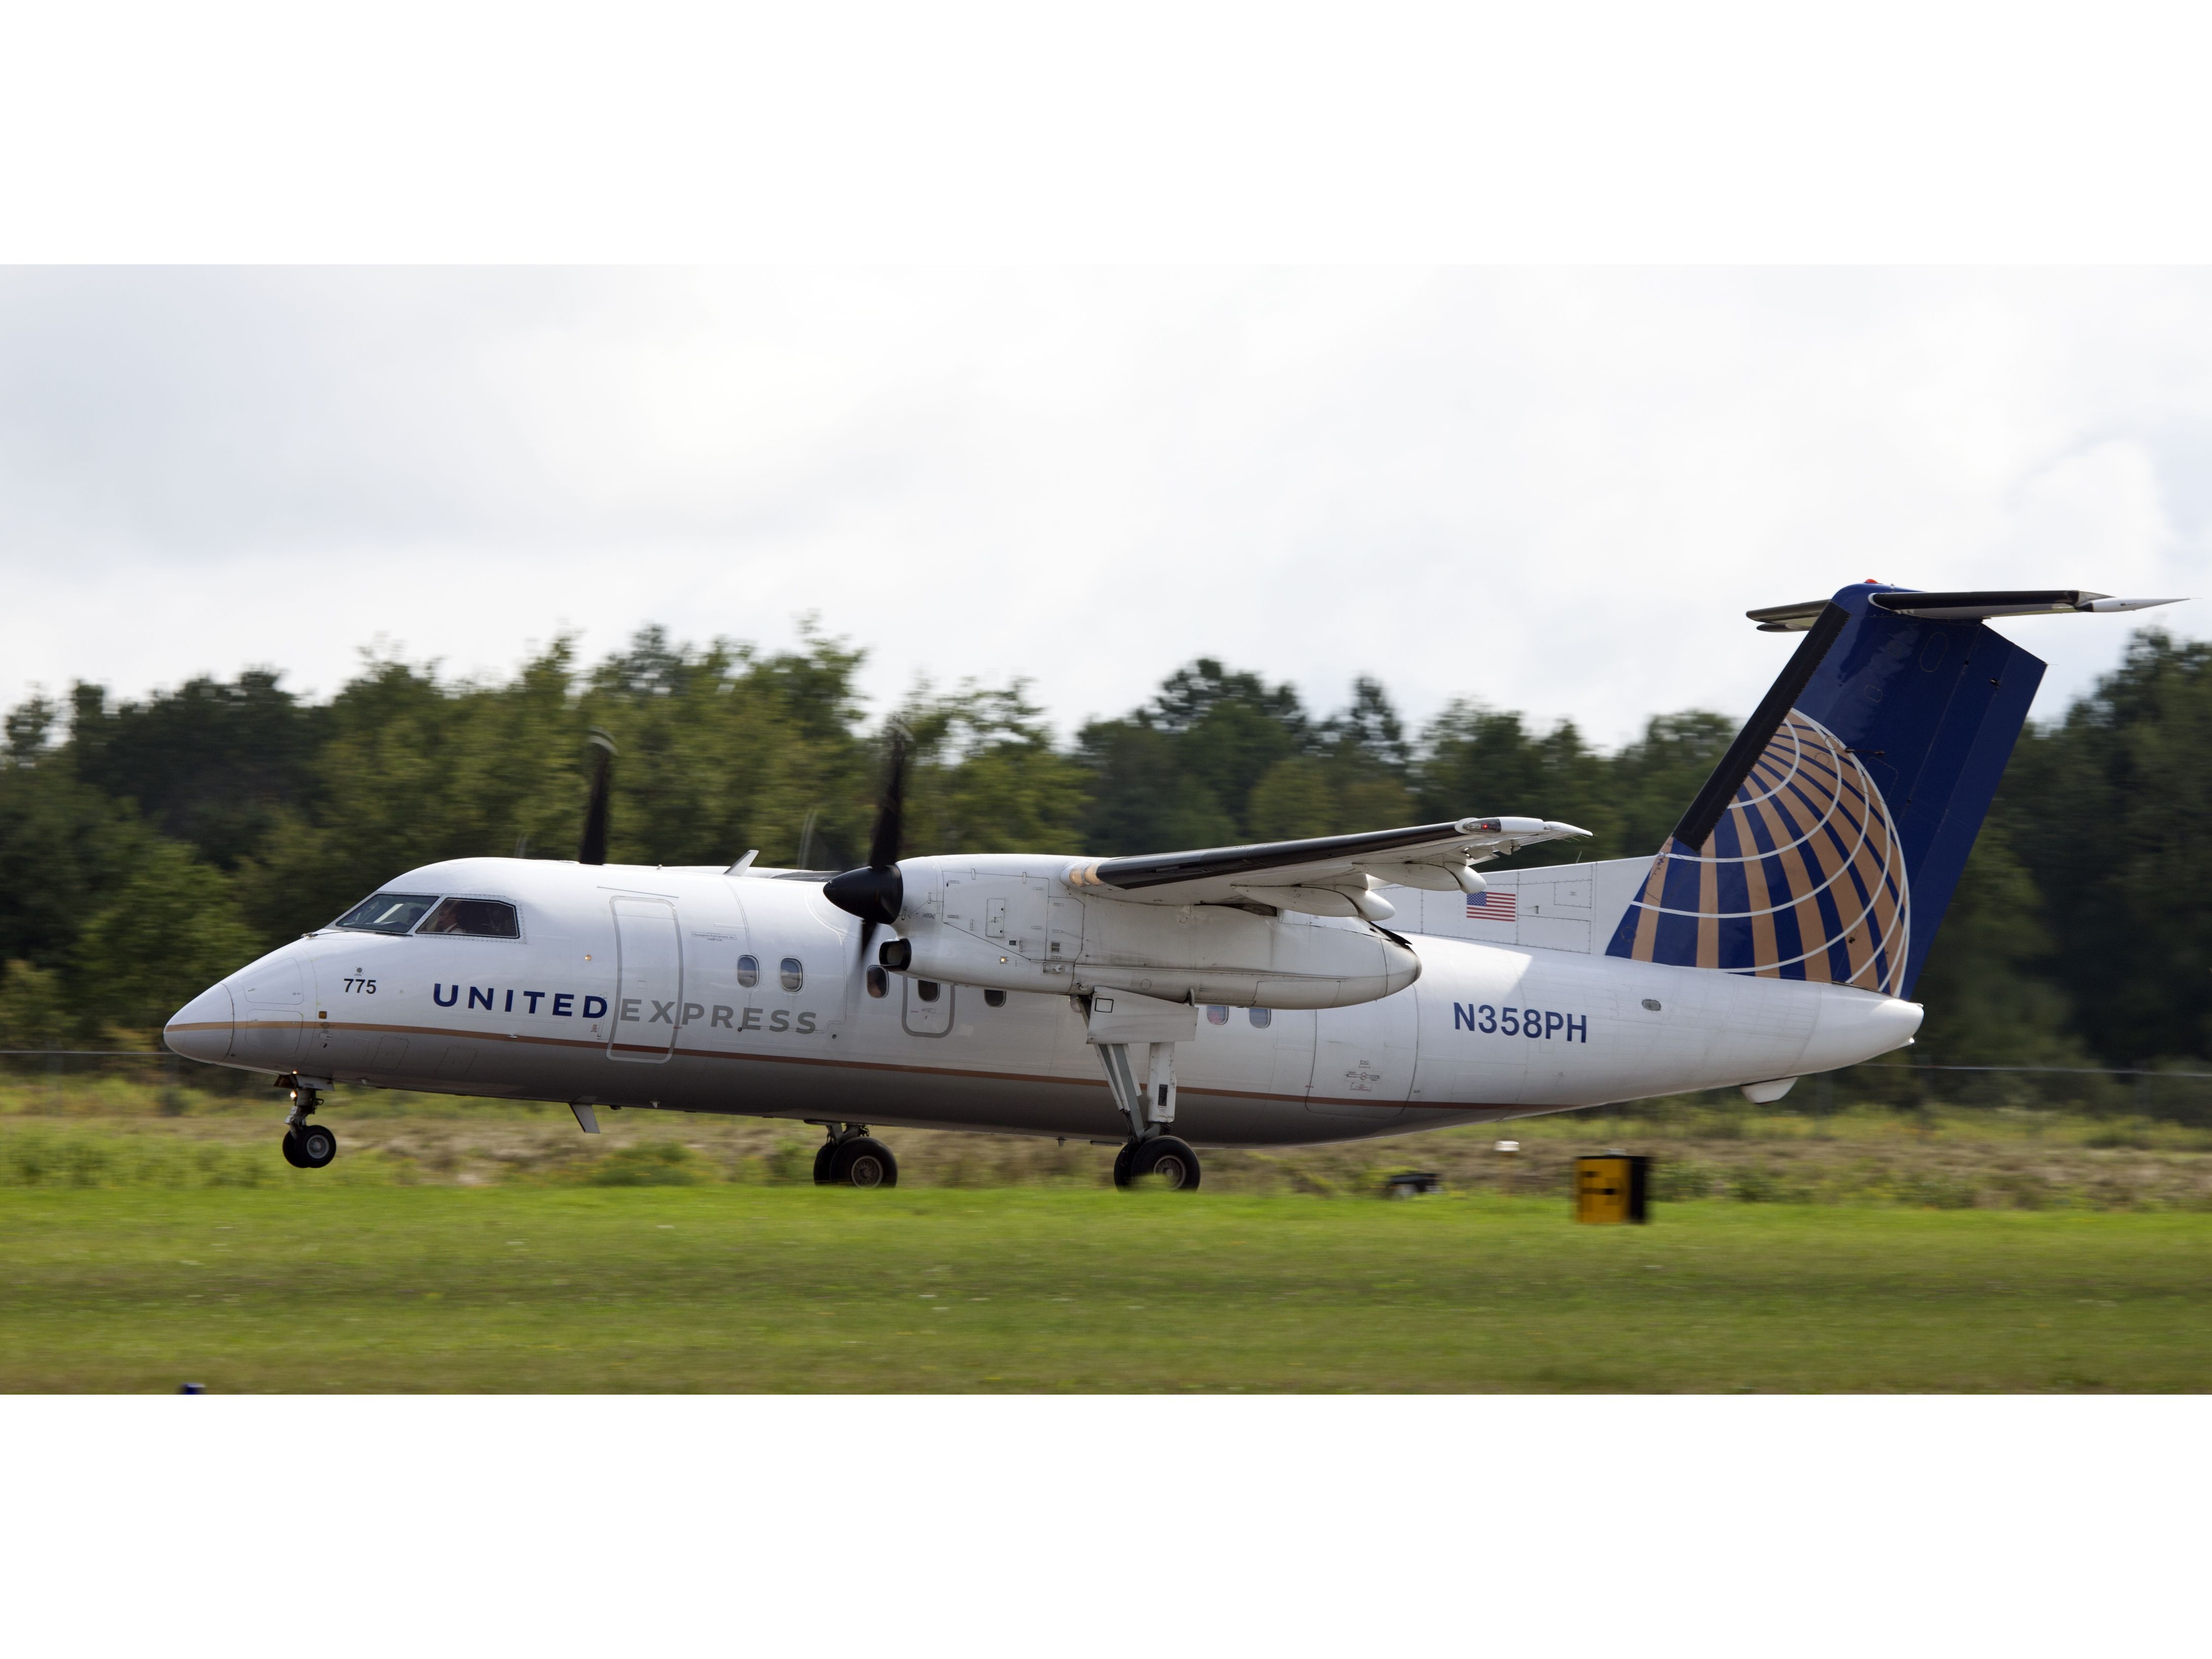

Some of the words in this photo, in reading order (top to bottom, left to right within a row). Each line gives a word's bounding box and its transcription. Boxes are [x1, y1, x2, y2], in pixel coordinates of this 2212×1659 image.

[343, 978, 377, 995] 775
[433, 983, 608, 1019] UNITED
[619, 998, 817, 1035] EXPRESS
[1453, 1002, 1587, 1043] N358PH
